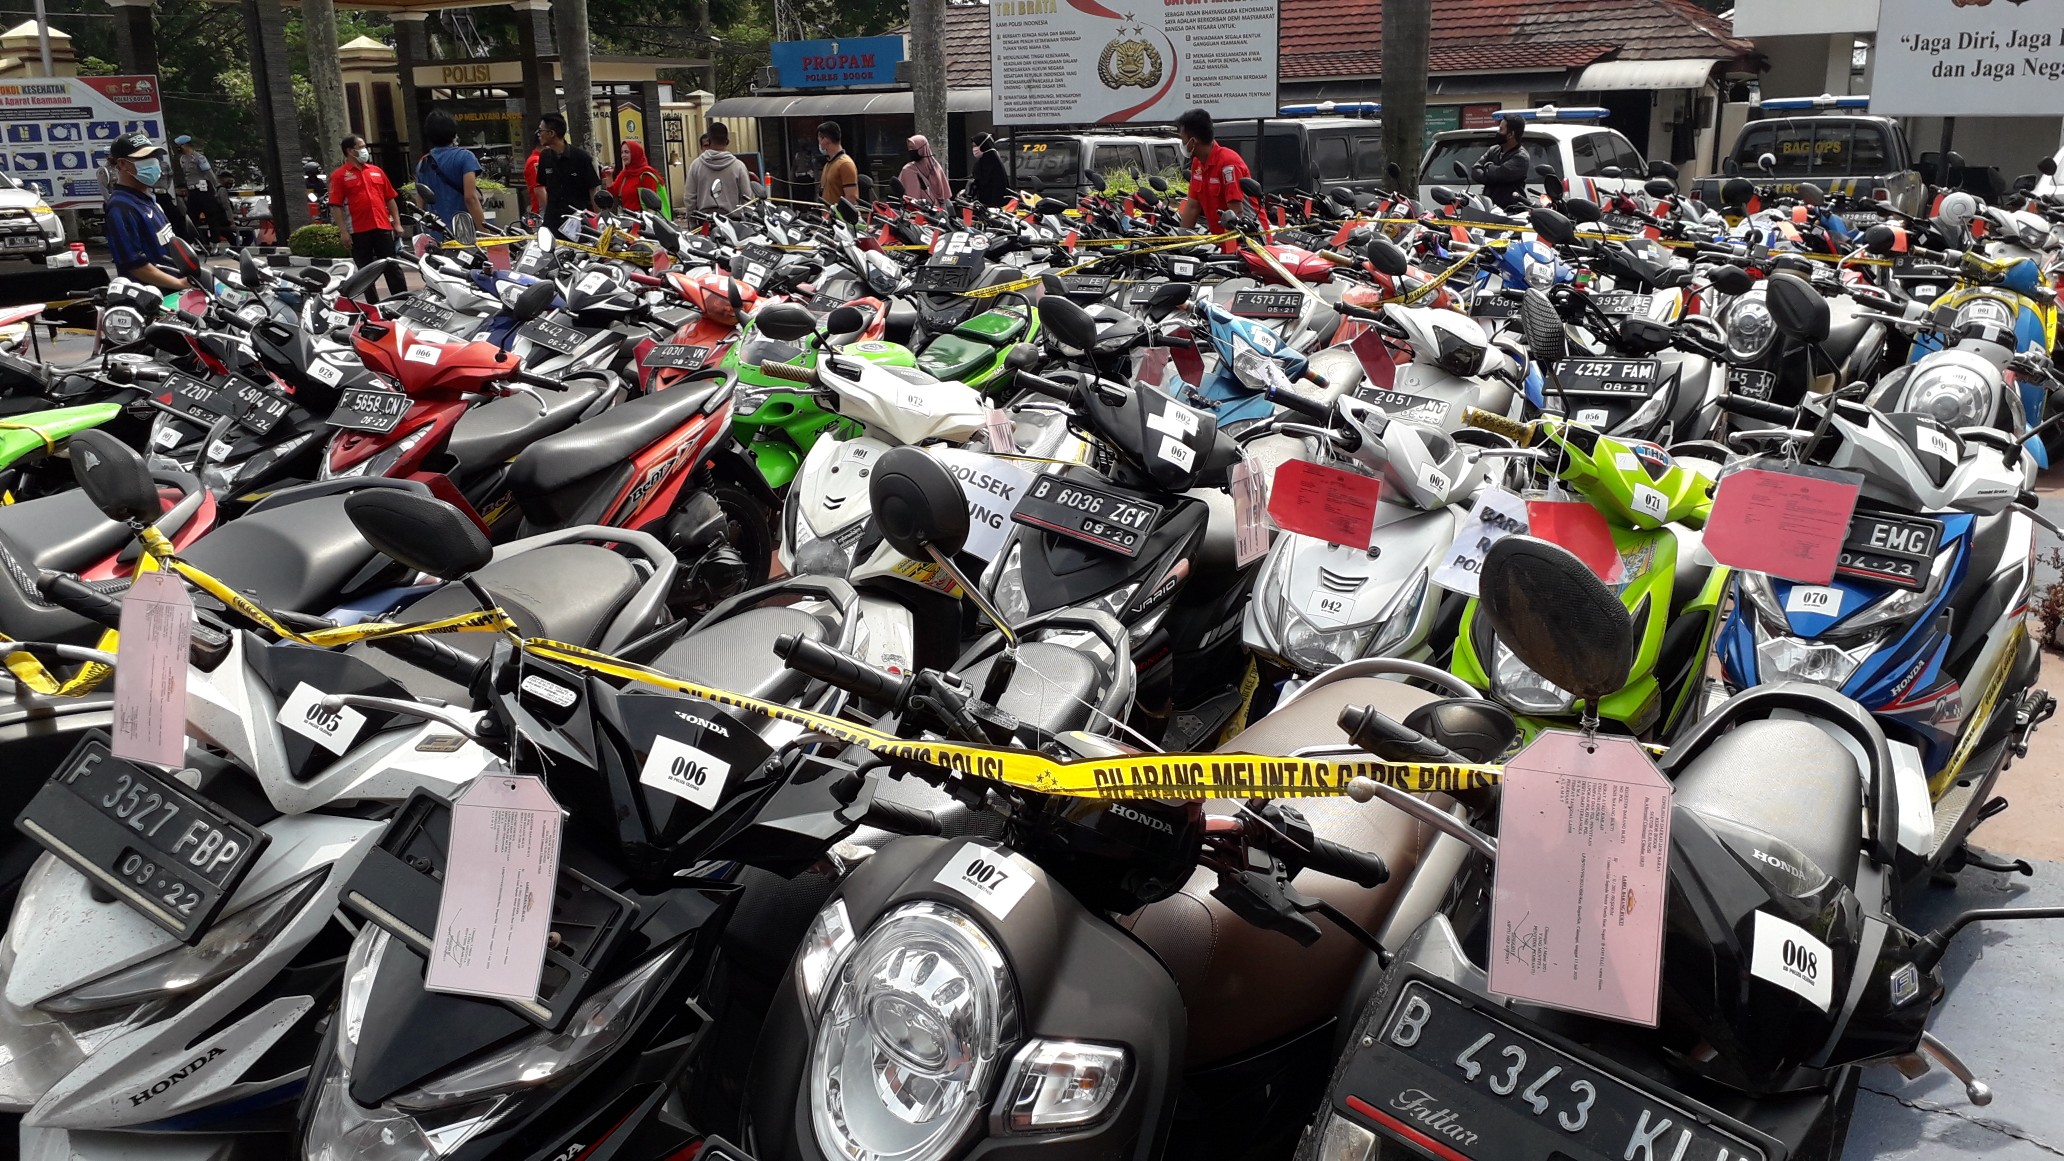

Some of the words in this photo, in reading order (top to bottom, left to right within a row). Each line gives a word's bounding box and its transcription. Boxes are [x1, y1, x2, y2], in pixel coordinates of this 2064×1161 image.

[1958, 31, 2000, 52] Diri,
[2006, 29, 2051, 52] Jaga
[802, 53, 876, 72] PROPAM
[1932, 61, 1965, 77] dan
[1971, 59, 2015, 82] Jaga
[443, 64, 491, 83] POLISI
[805, 73, 838, 82] POLRES
[843, 71, 874, 81] BOGOR
[22, 85, 67, 96] KESEHATAN
[5, 97, 30, 107] Aparat
[32, 95, 72, 105] Keamanan
[1023, 144, 1031, 152] T
[1032, 144, 1047, 152] 20
[1783, 142, 1810, 153] BAG
[1815, 141, 1841, 152] OPS
[406, 297, 412, 306] B
[1236, 295, 1244, 304] F
[1249, 295, 1276, 305] 4573
[416, 348, 432, 358] 066
[318, 365, 335, 379] 078
[1556, 363, 1566, 376] F
[1574, 363, 1610, 376] 4252
[1622, 365, 1653, 379] FAM
[165, 376, 178, 389] F
[223, 376, 238, 390] F
[266, 401, 289, 418] DA
[341, 391, 350, 407] F
[354, 392, 382, 412] 5658
[384, 398, 398, 414] CN
[907, 394, 924, 406] 072
[1357, 389, 1368, 399] F
[1175, 410, 1191, 426] 002
[1171, 445, 1187, 461] 067
[1931, 435, 1948, 452] 001
[1428, 472, 1445, 490] 002
[1034, 481, 1051, 498] B
[1057, 488, 1104, 514] 6036
[1109, 503, 1150, 528] ZGV
[1645, 493, 1661, 510] 071
[967, 500, 1004, 530] UNG
[1870, 524, 1925, 553] EMG
[1131, 579, 1176, 613] VARIO
[1320, 597, 1343, 612] 042
[1803, 591, 1828, 605] 070
[1890, 659, 1925, 697] HONDA
[305, 703, 343, 732] 005
[674, 710, 730, 738] HONDA
[671, 755, 709, 786] 006
[938, 752, 1004, 781] POLISI
[1094, 762, 1205, 797] DILARANG
[1211, 762, 1330, 789] MELINTAS
[66, 753, 103, 784] F
[102, 773, 181, 837] 3527
[171, 818, 241, 874] FBP
[1109, 803, 1174, 836] HONDA
[966, 858, 1009, 890] 007
[1752, 848, 1808, 882] HONDA
[1782, 939, 1817, 980] 008
[1390, 995, 1433, 1049] B
[1454, 1032, 1598, 1133] 4343
[128, 1047, 228, 1108] HONDA
